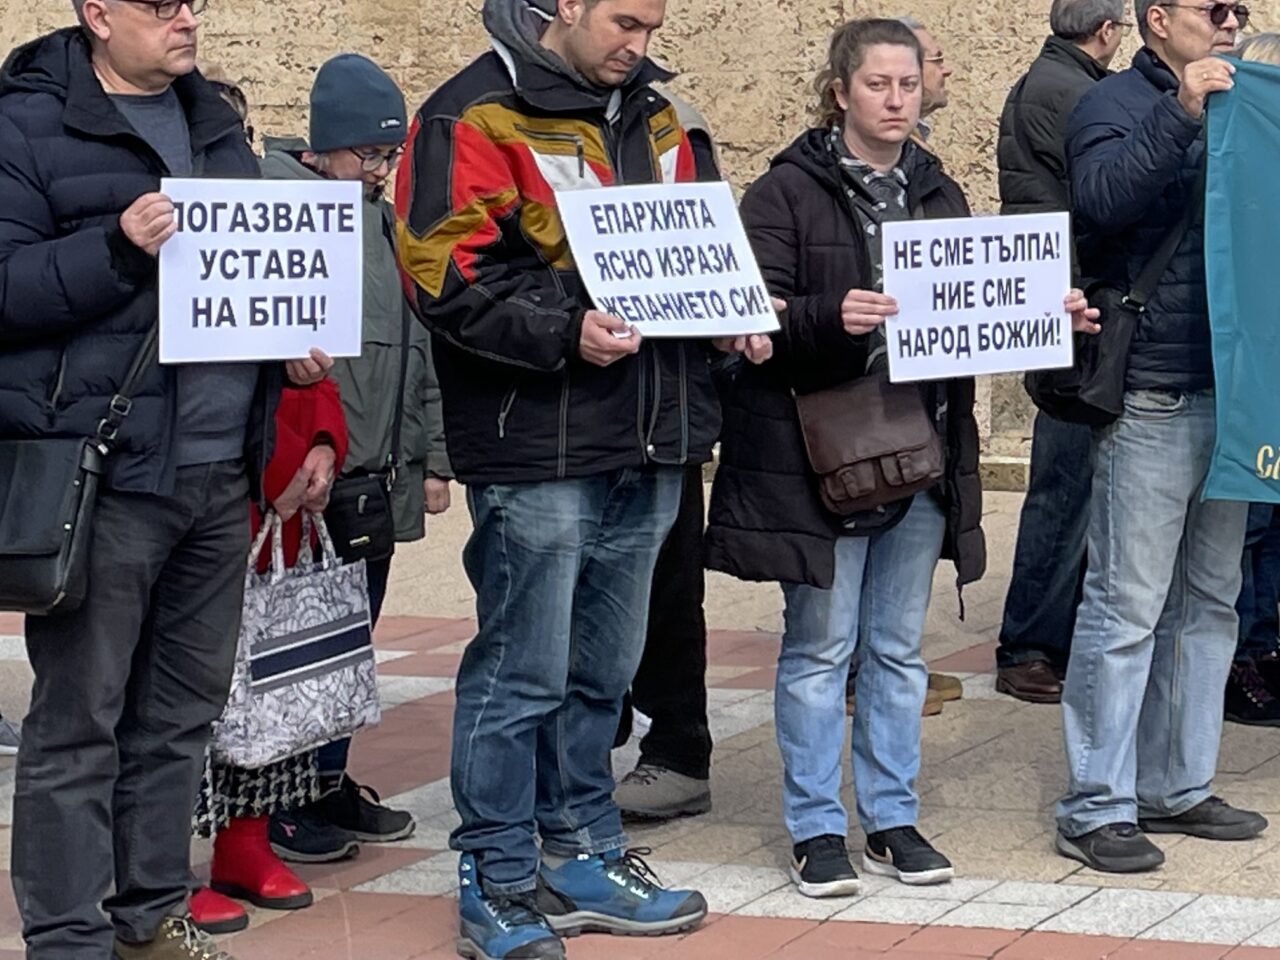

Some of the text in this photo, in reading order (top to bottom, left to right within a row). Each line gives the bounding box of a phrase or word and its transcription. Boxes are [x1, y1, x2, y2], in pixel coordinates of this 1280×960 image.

[590, 198, 716, 235] ЕПАРХИЯТА
[199, 248, 329, 280] УСТАВА
[593, 242, 741, 281] ЯСНО ИЗРАЗИ
[893, 231, 1061, 270] НЕ СМЕ ТЪЛПА!
[597, 285, 771, 322] ЖЕЛАНИЕТО СИ!
[932, 276, 1027, 311] НИЕ СМЕ
[191, 295, 327, 331] НА БПЦ!
[897, 311, 1061, 359] НАРОД БОЖИЙ!
